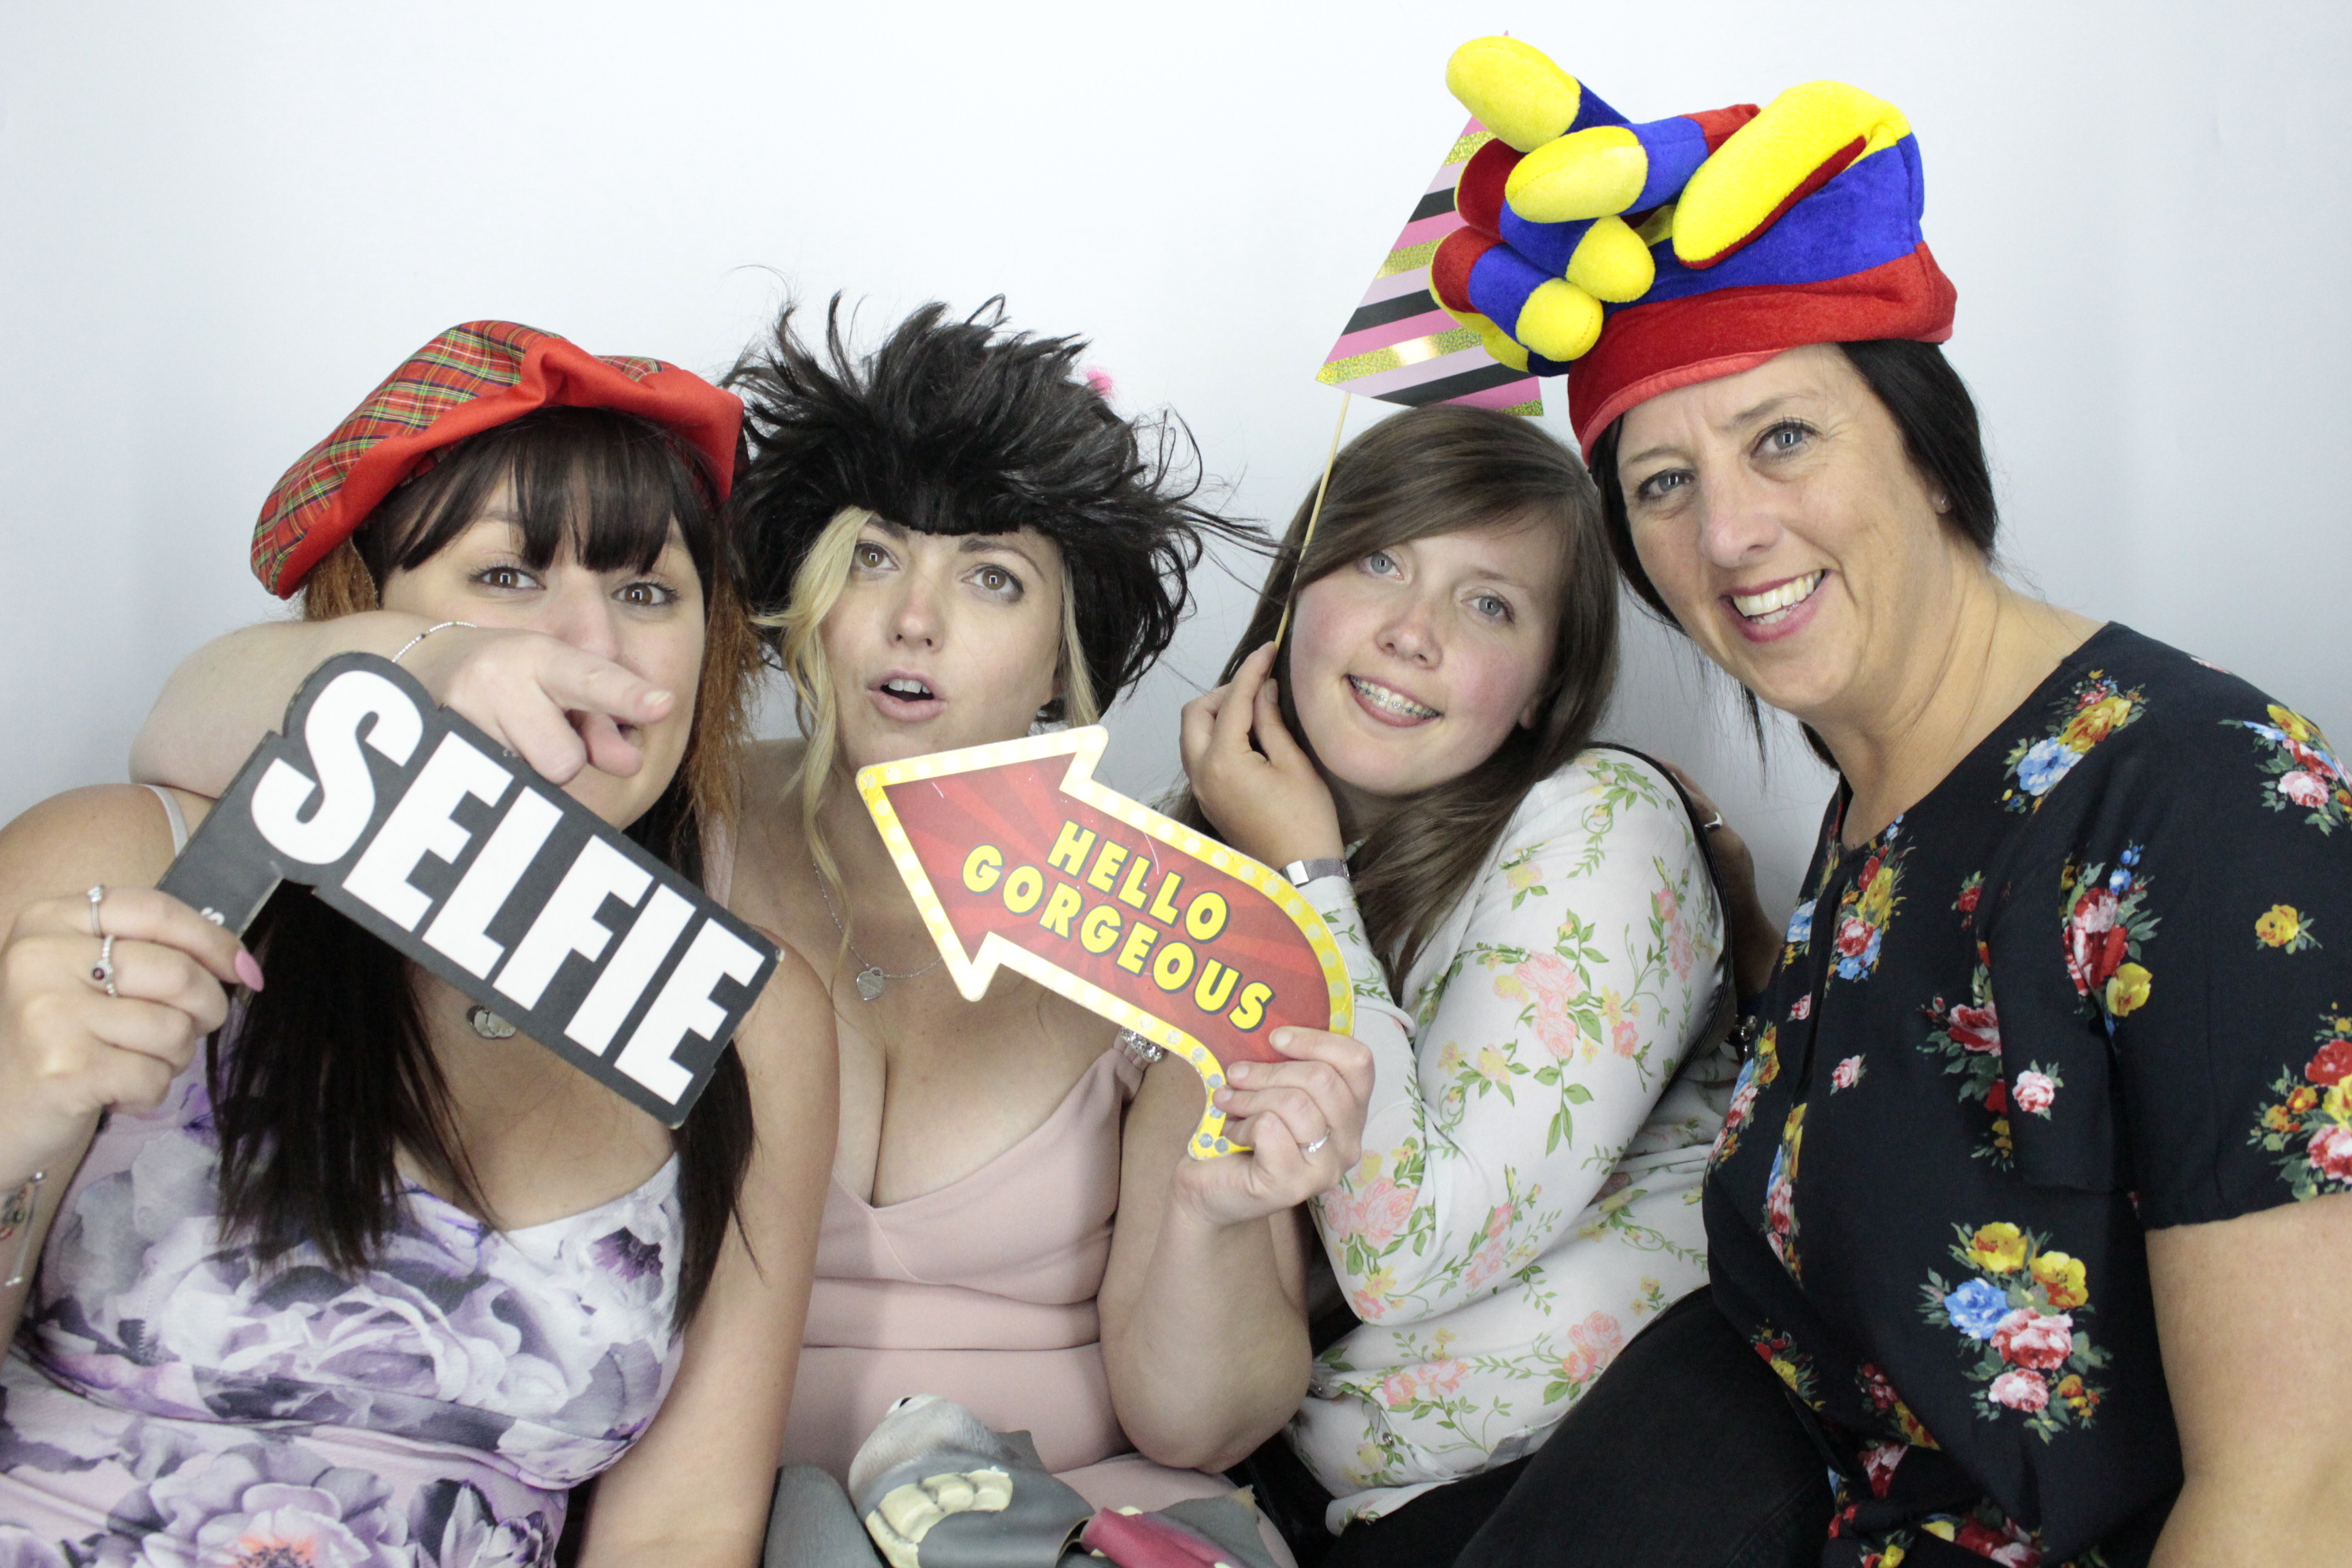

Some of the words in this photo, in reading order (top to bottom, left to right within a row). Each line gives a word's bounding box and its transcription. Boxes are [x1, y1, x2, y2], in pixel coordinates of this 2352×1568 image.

[252, 670, 765, 1105] SELFIE
[961, 844, 1274, 1032] GORGEOUS
[1047, 820, 1228, 943] HELLO
